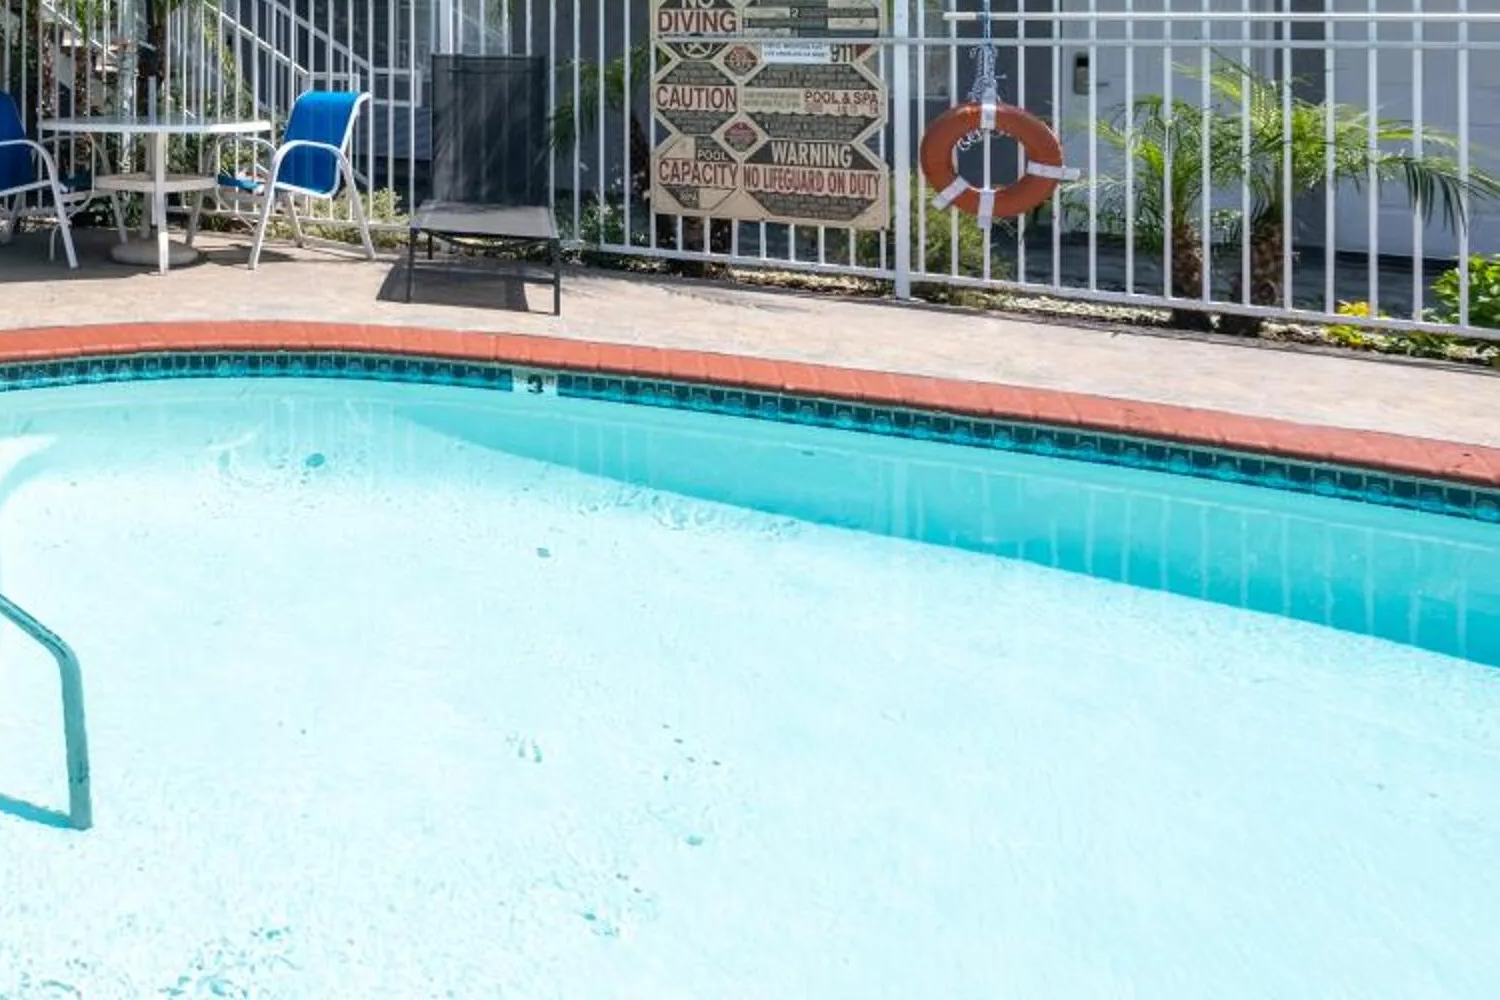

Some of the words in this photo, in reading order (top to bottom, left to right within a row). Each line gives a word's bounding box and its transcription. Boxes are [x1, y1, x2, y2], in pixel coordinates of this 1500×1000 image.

[658, 10, 737, 33] DIVING
[830, 42, 853, 63] 911
[656, 86, 737, 110] CAUTION
[804, 91, 839, 104] POOL
[841, 93, 851, 105] &
[853, 92, 879, 106] SPA
[697, 149, 729, 161] POOL
[771, 140, 853, 169] WARNING
[659, 160, 739, 187] CAPACITY
[743, 165, 760, 189] NO
[763, 167, 824, 193] LIFEGUARD
[827, 170, 846, 194] ON
[849, 172, 880, 197] DUTY
[527, 374, 544, 394] 3
